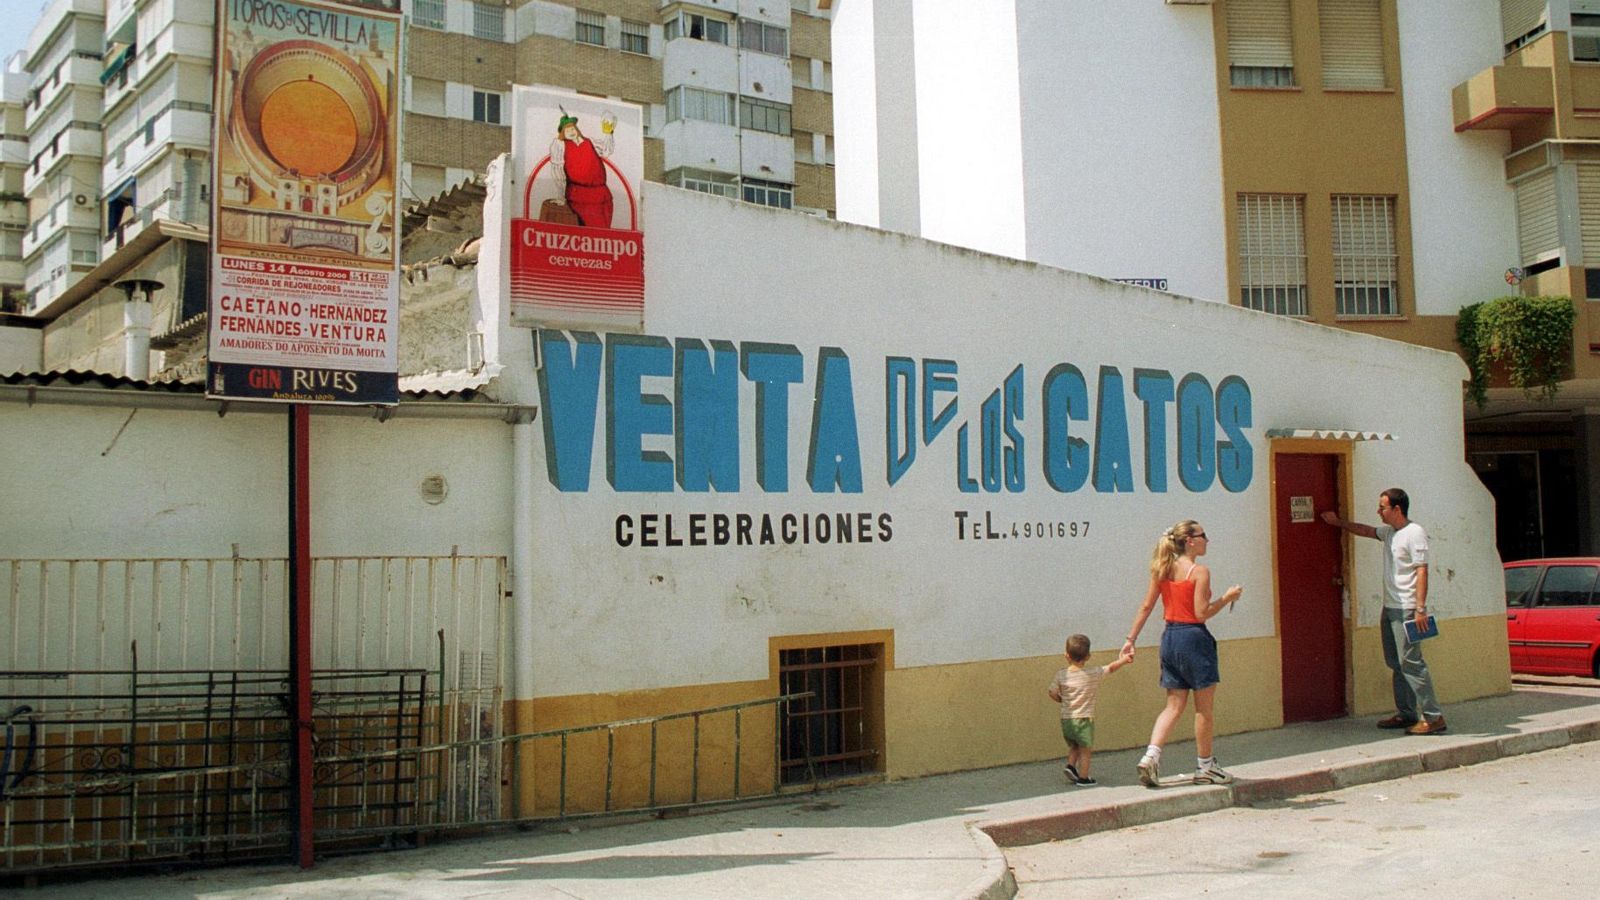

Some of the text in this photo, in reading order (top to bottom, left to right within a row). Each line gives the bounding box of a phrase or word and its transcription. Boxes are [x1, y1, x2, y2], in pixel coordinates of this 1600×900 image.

[295, 9, 369, 45] SEVILLA
[523, 227, 638, 261] Cruzcampo
[223, 258, 265, 271] LUNES
[269, 263, 286, 273] 14
[326, 271, 347, 279] 2000
[548, 255, 613, 270] cervezas
[236, 276, 270, 286] CORRIDA
[271, 279, 282, 287] DE
[283, 281, 342, 293] REJONEADORES
[220, 295, 301, 317] CAETANO
[220, 315, 387, 343] FERNANDES VENTURA
[219, 338, 273, 351] AMADORES
[275, 342, 289, 352] DO
[290, 343, 340, 355] APOSENTO
[341, 346, 354, 356] DA
[356, 347, 386, 359] MOITA
[248, 367, 358, 394] GIN RIVES
[535, 328, 864, 494] VENTA
[885, 355, 959, 489] DE
[957, 363, 1026, 493] LOS
[615, 512, 893, 547] CELEBRACIONES
